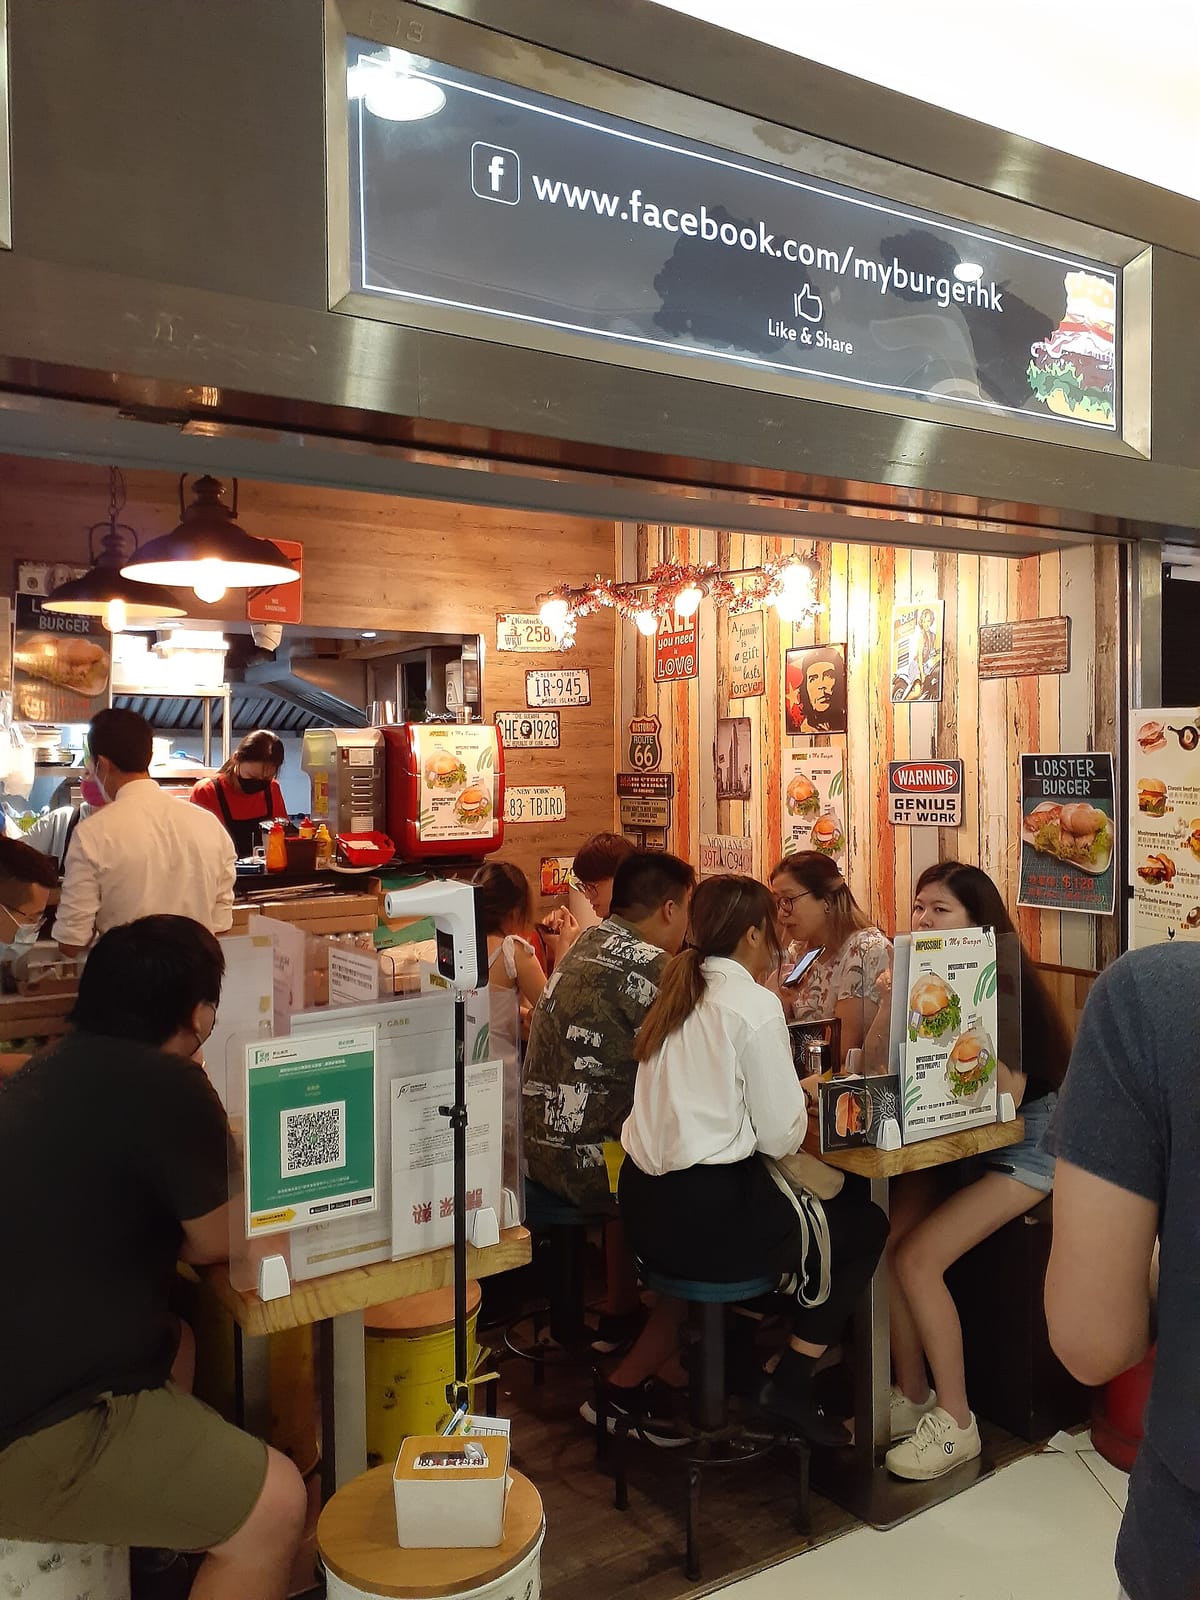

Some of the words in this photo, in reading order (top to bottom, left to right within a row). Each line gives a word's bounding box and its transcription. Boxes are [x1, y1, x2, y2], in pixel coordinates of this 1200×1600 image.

[532, 175, 1004, 312] www.facebook.com/myburgerhk
[768, 319, 796, 342] Like
[801, 330, 812, 344] &
[816, 331, 853, 354] Share
[40, 616, 89, 632] BURGER
[658, 611, 694, 636] ALL
[731, 622, 738, 633] A
[526, 626, 556, 642] 258
[658, 637, 673, 650] you
[674, 632, 694, 644] need
[741, 640, 747, 648] is
[742, 646, 759, 664] gift
[743, 664, 761, 680] lasts
[536, 678, 581, 697] IR-945
[730, 680, 762, 694] forever
[498, 720, 518, 740] CHE
[533, 720, 558, 740] 1928
[633, 736, 654, 744] ROUTE
[634, 744, 653, 766] 66
[1034, 760, 1096, 777] LOBSTER
[898, 770, 953, 786] WARNING
[1042, 779, 1090, 795] BURGER
[530, 798, 562, 816] TBIRD
[895, 799, 956, 810] GENIUS
[894, 812, 911, 821] AT
[917, 813, 956, 822] WORK
[707, 836, 742, 850] MONTANA
[553, 868, 573, 886] 07
[916, 940, 941, 951] IMPOSSIBLE
[949, 938, 960, 946] My
[962, 937, 981, 945] Burger
